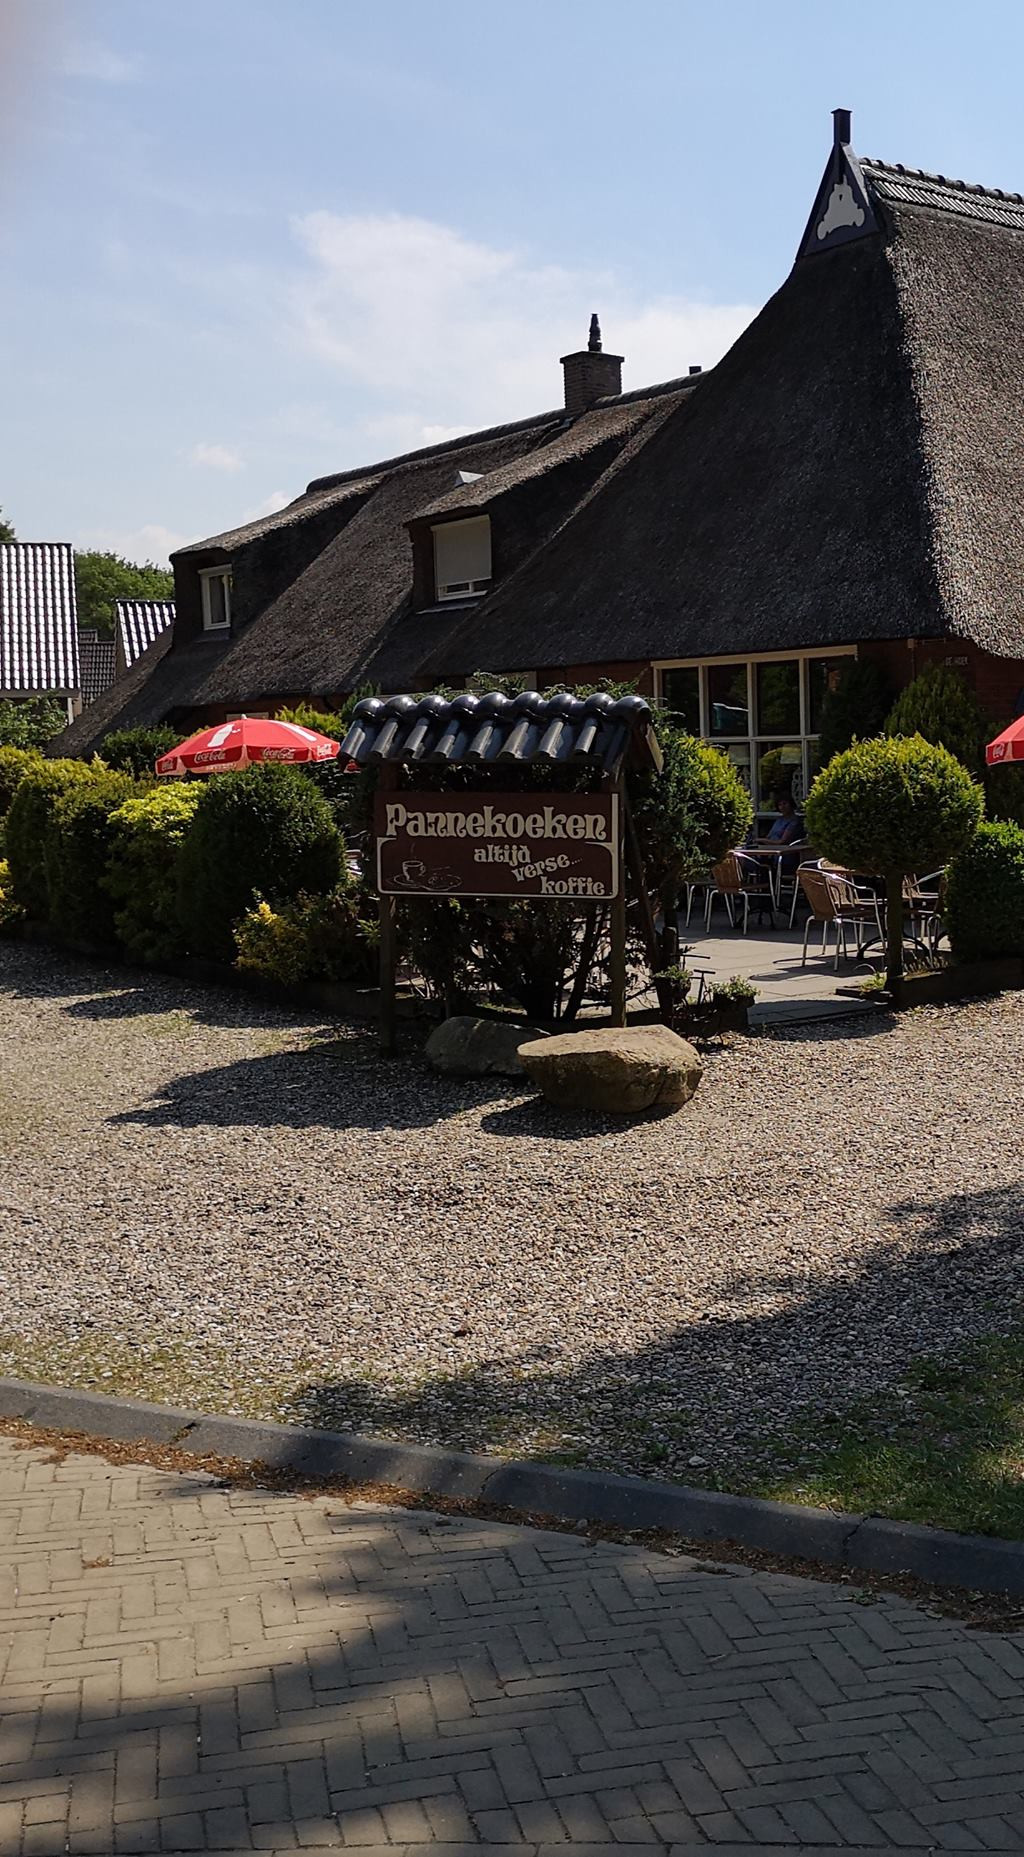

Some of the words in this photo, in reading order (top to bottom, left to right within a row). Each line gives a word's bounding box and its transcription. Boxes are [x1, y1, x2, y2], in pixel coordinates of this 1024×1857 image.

[386, 803, 607, 840] Pannekoeken
[473, 844, 532, 866] altijd
[539, 876, 606, 896] koffie
